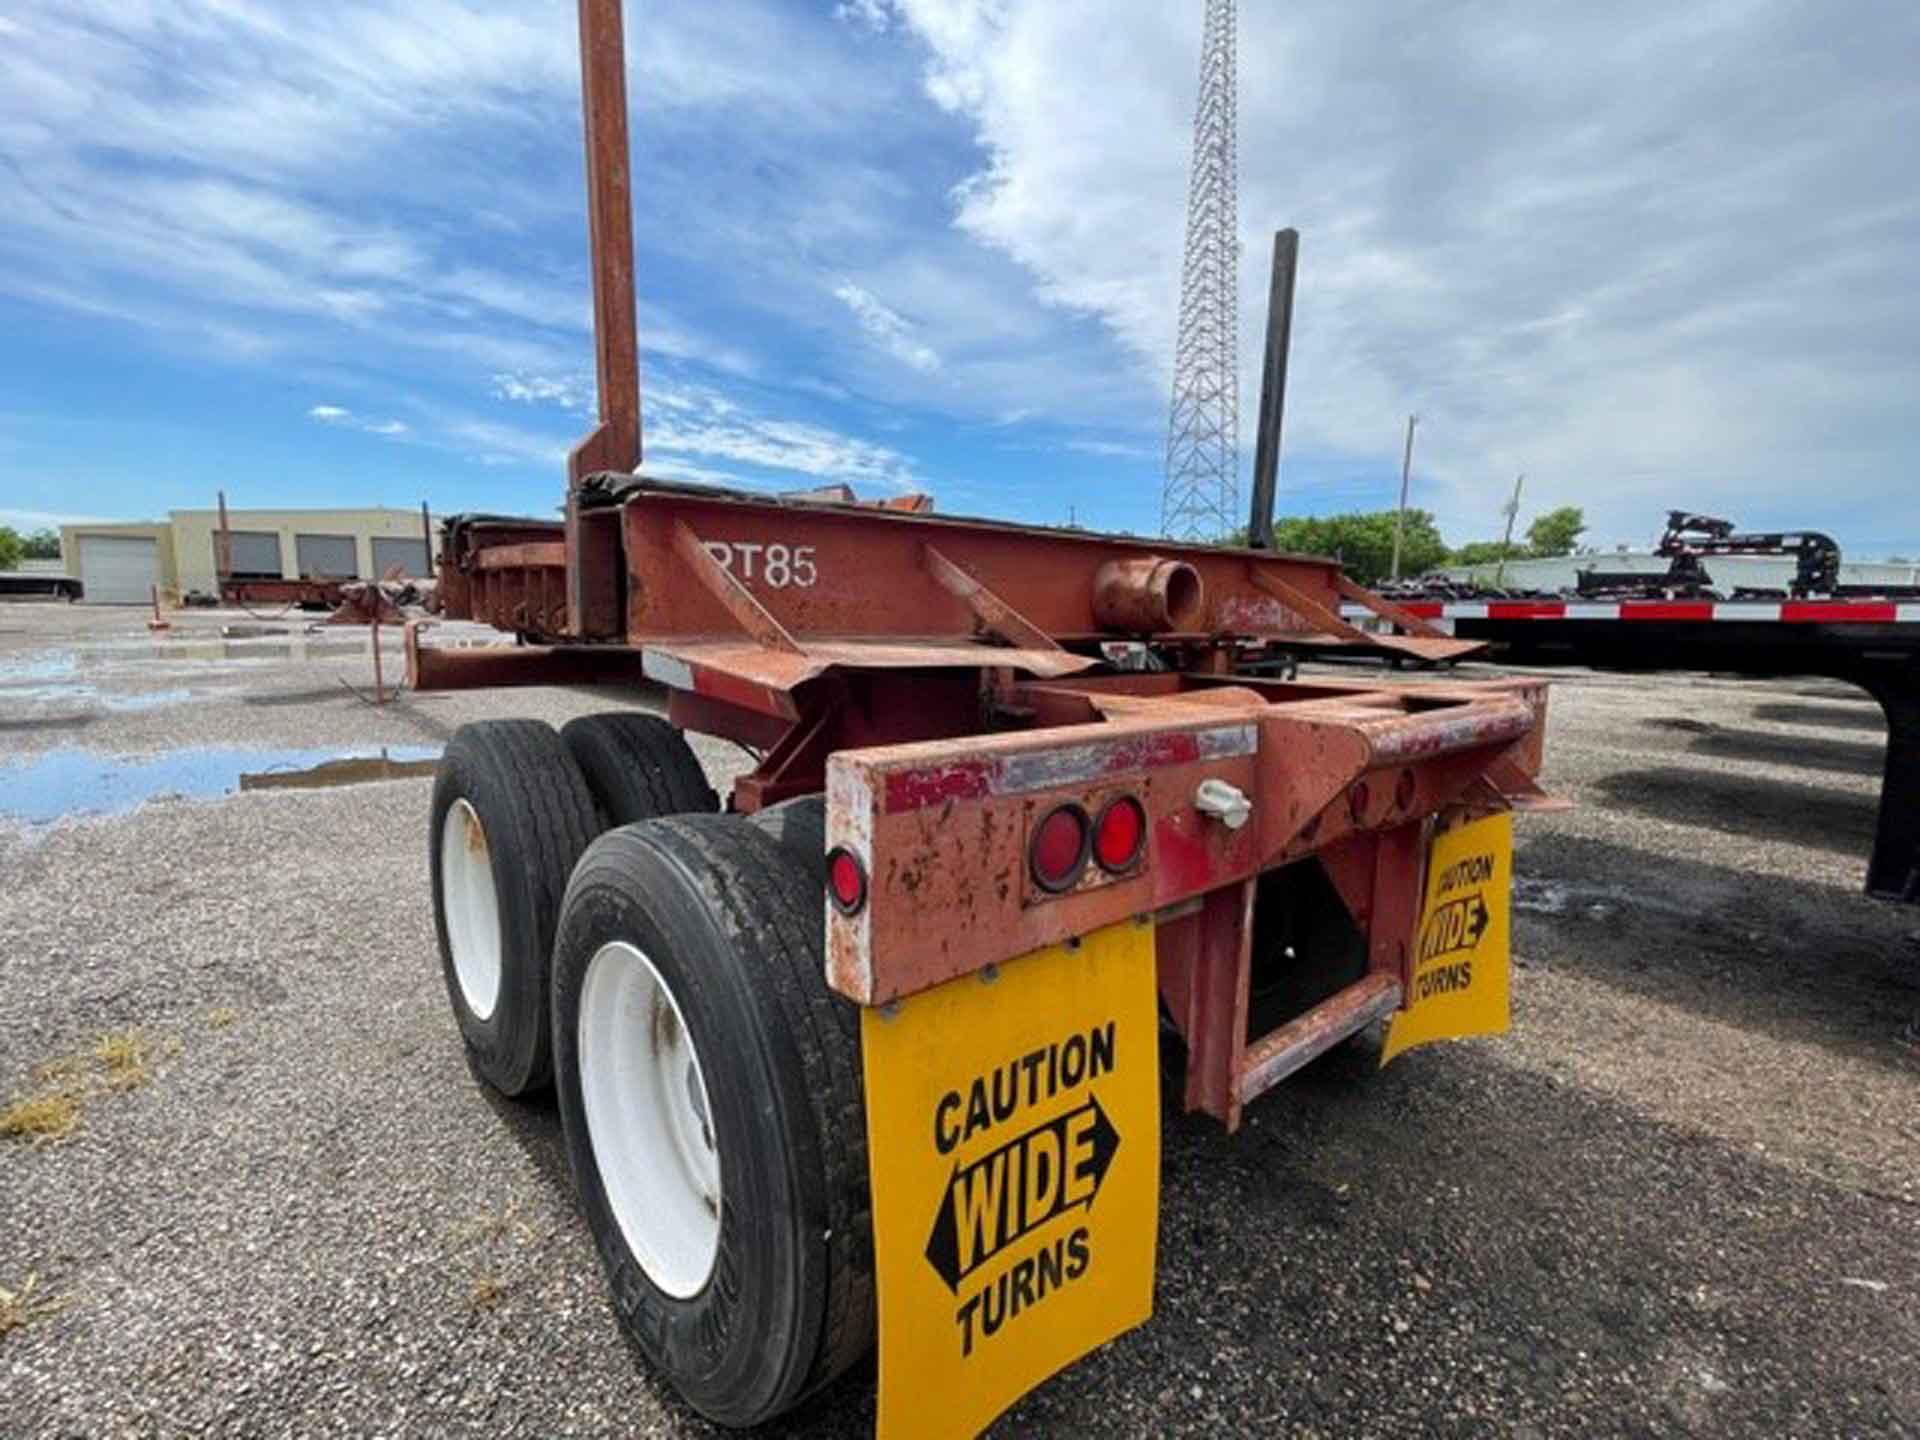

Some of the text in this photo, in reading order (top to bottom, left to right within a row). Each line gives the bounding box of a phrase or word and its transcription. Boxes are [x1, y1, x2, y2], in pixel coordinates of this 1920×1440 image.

[934, 1020, 1116, 1155] CAUTION
[953, 1106, 1098, 1273] WIDE
[956, 1226, 1090, 1358] TURNS
